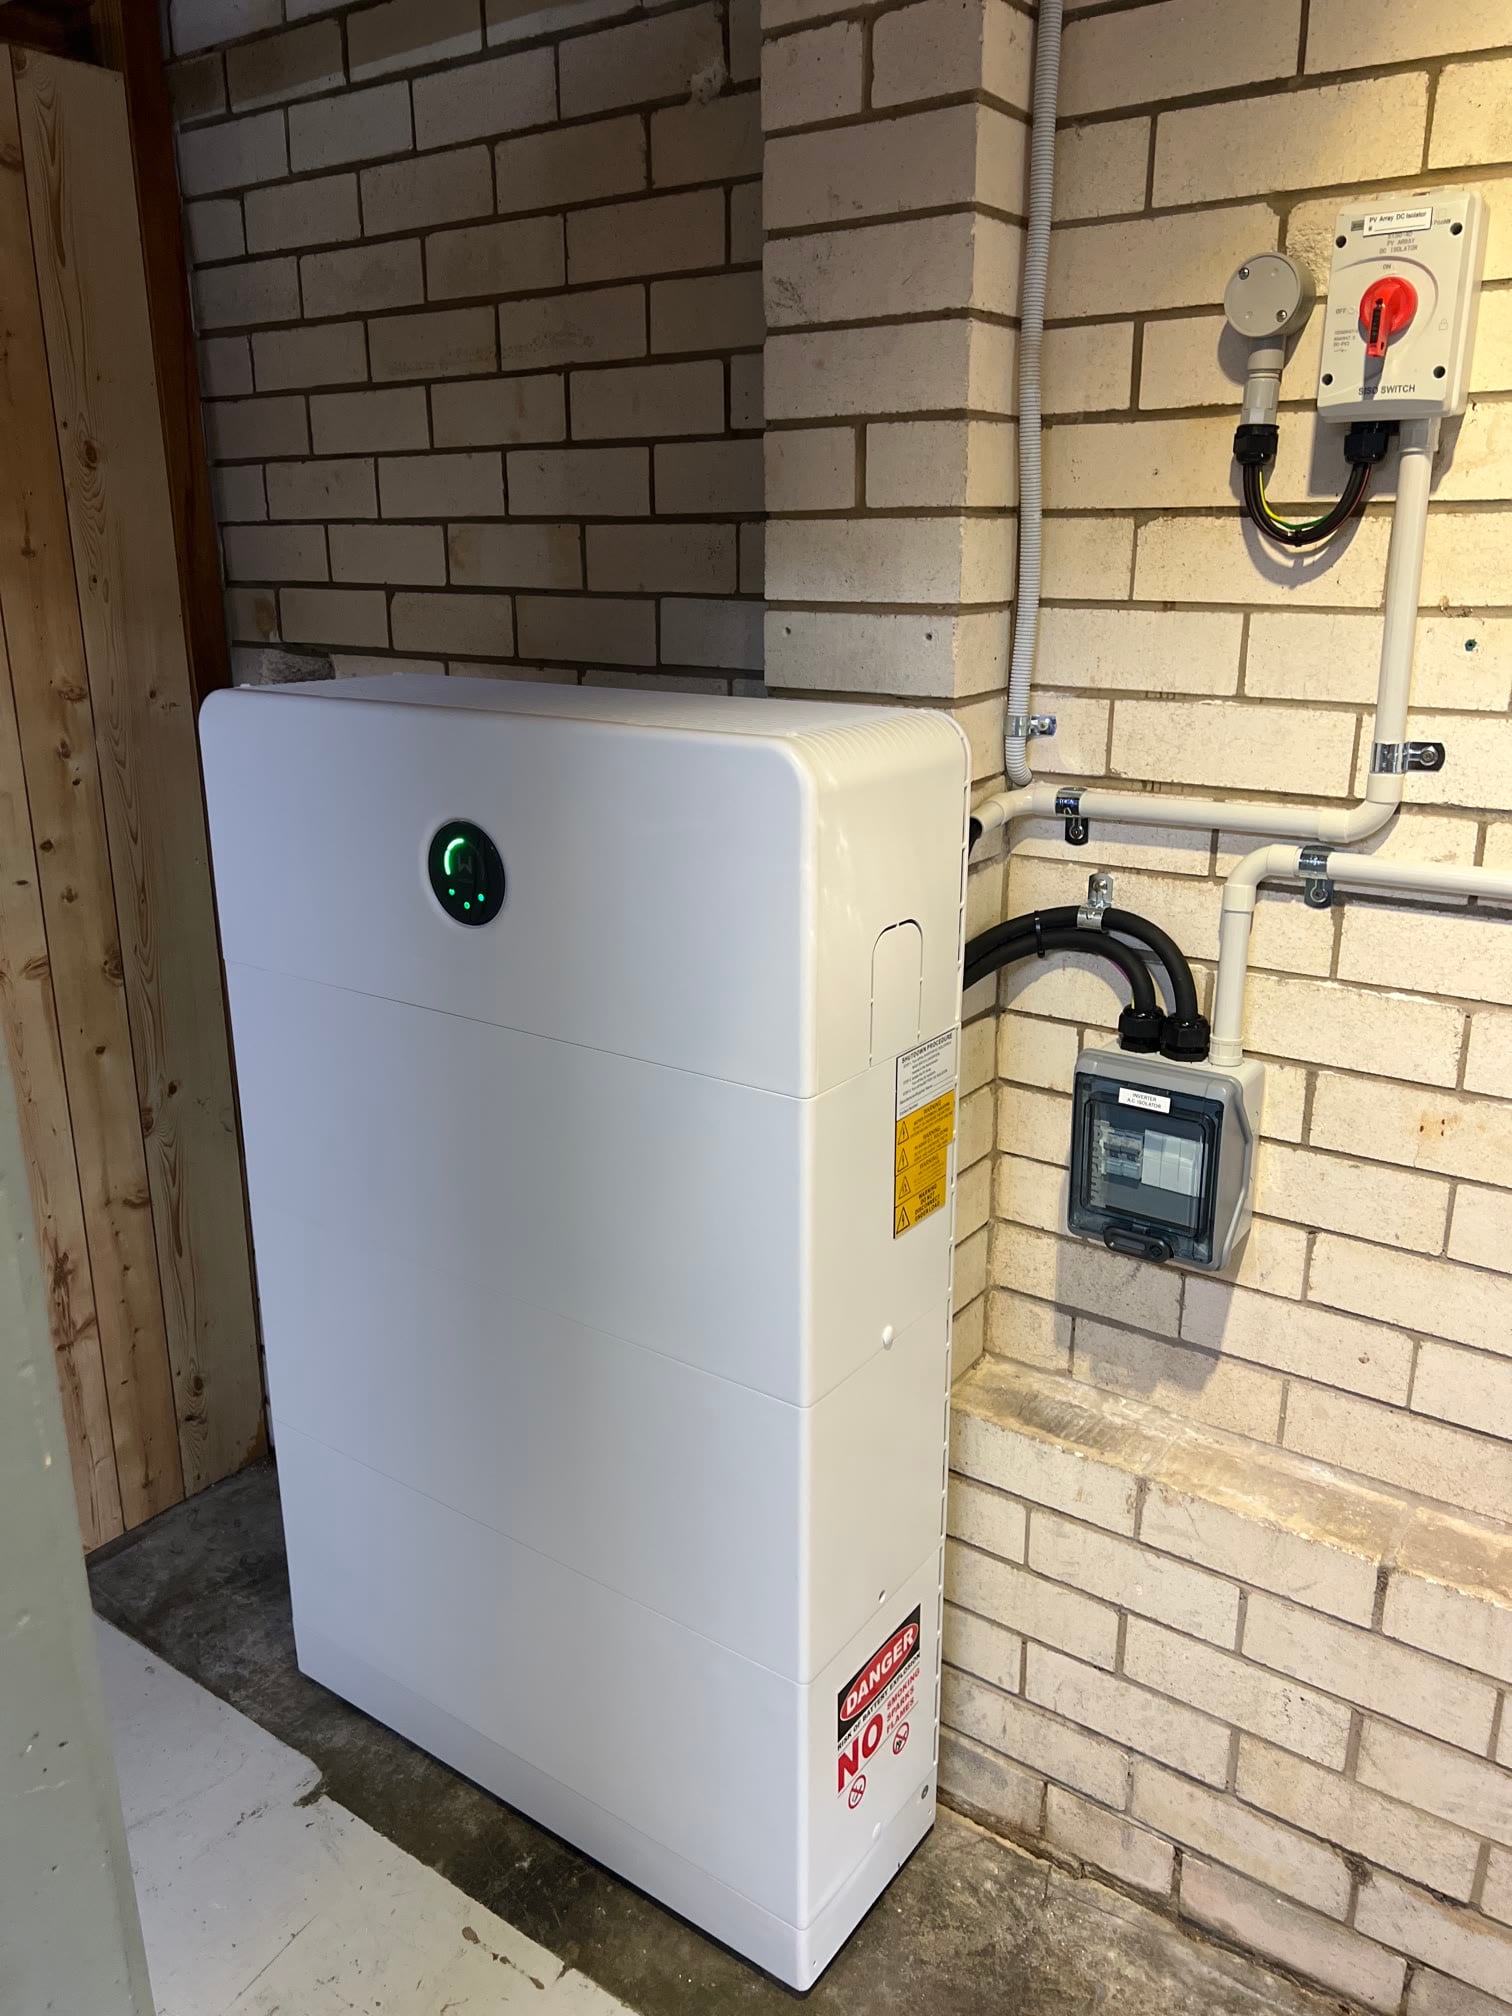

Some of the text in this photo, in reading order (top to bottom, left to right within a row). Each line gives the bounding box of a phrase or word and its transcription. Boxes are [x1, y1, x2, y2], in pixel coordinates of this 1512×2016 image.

[1380, 215, 1394, 223] Array
[1406, 211, 1427, 219] Isolator
[1390, 245, 1418, 253] ISOLATOR
[1380, 384, 1416, 394] SWITCH
[1132, 1093, 1157, 1102] INVERTER
[1136, 1099, 1162, 1109] ISOLATOR
[918, 1183, 937, 1199] WARNING
[845, 1626, 914, 1716] DANGER
[837, 1653, 921, 1750] RISK OF BATTERY EXPLOSION
[886, 1667, 921, 1711] SMOKING
[886, 1685, 915, 1723] SPARKS
[886, 1698, 915, 1735] FLAMES
[838, 1713, 883, 1793] NO
